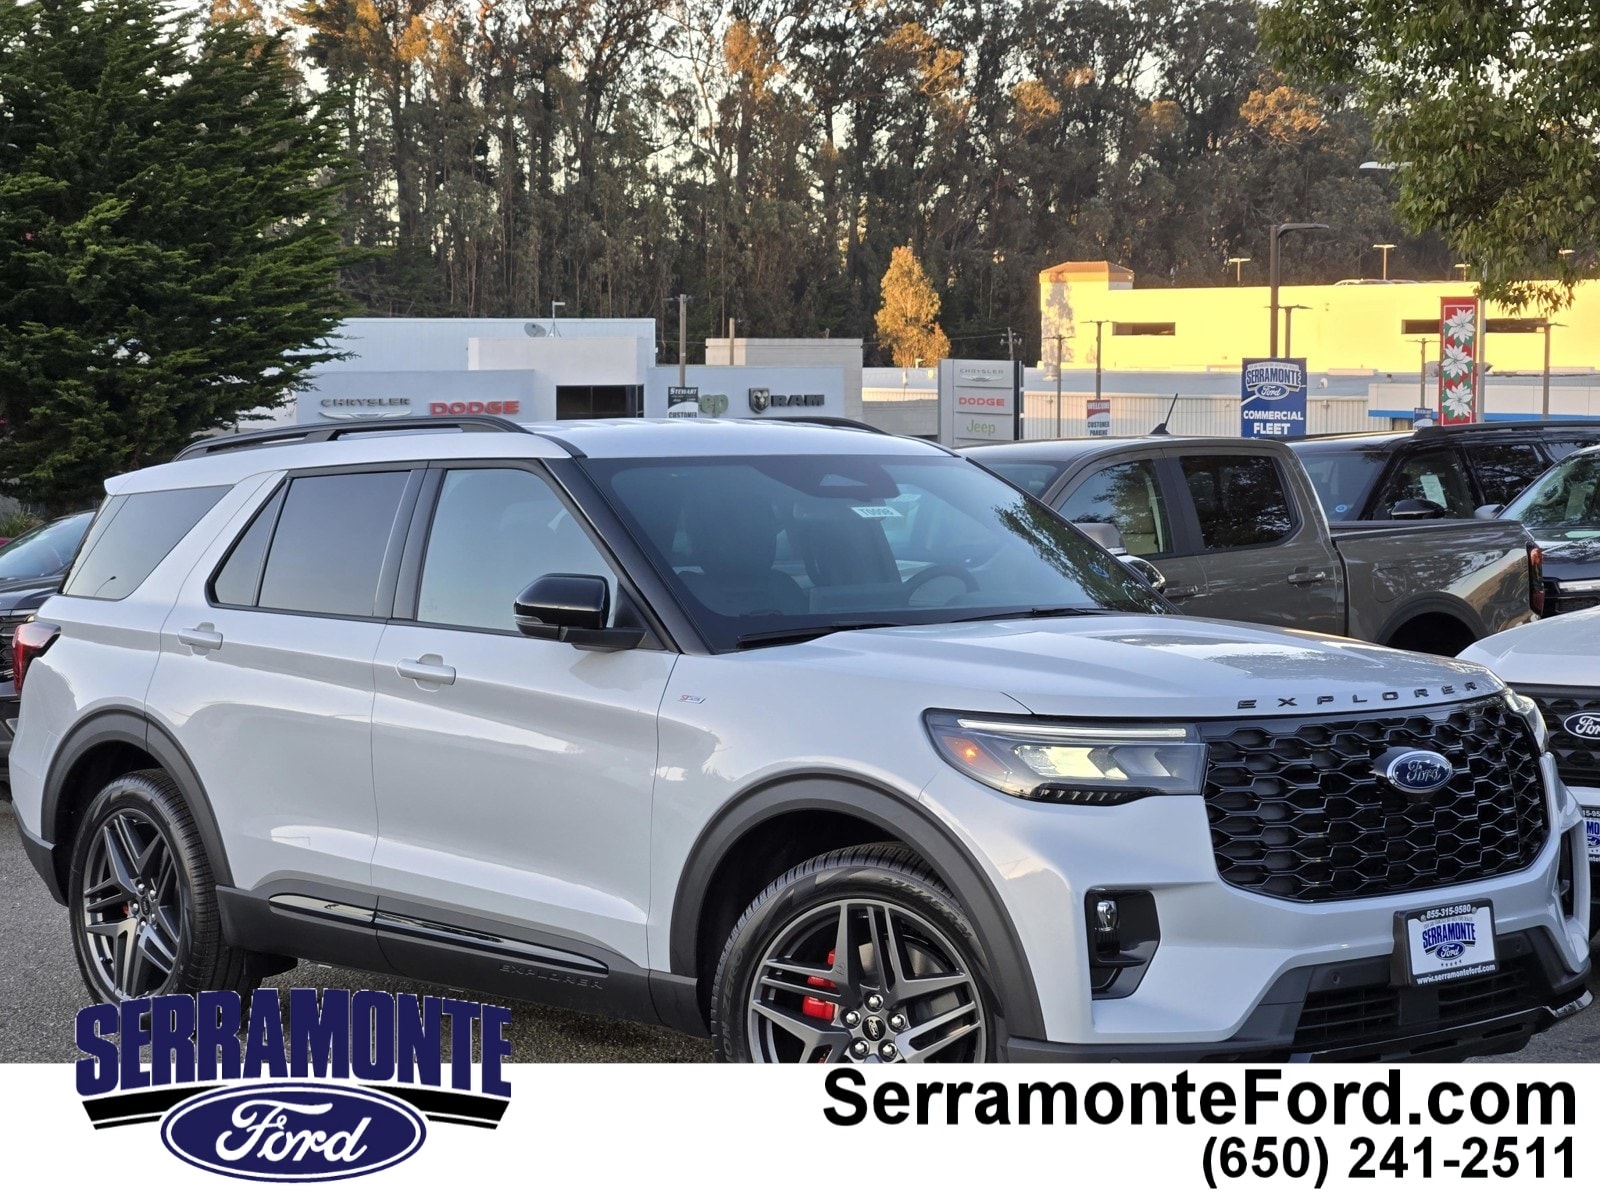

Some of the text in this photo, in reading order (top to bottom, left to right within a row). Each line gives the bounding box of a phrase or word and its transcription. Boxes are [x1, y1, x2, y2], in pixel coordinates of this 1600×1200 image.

[1246, 367, 1300, 385] SERRAMONTE
[1261, 386, 1281, 396] Ford
[320, 398, 411, 408] CHRYSLER
[771, 394, 824, 406] RAM
[959, 397, 1004, 406] DODGE
[430, 401, 520, 415] DODGE
[1243, 410, 1304, 420] COMMERCIAL
[966, 419, 996, 436] Jeep
[1254, 422, 1290, 434] FLEET
[1237, 682, 1478, 709] EXPLORER
[1406, 759, 1442, 782] Ford
[1426, 904, 1471, 919] 855-315-9580
[1422, 922, 1476, 949] SERRAMONTE
[1440, 945, 1460, 958] Ford
[500, 964, 602, 989] EXPLORER
[1416, 964, 1496, 985] www.serramonteford.com
